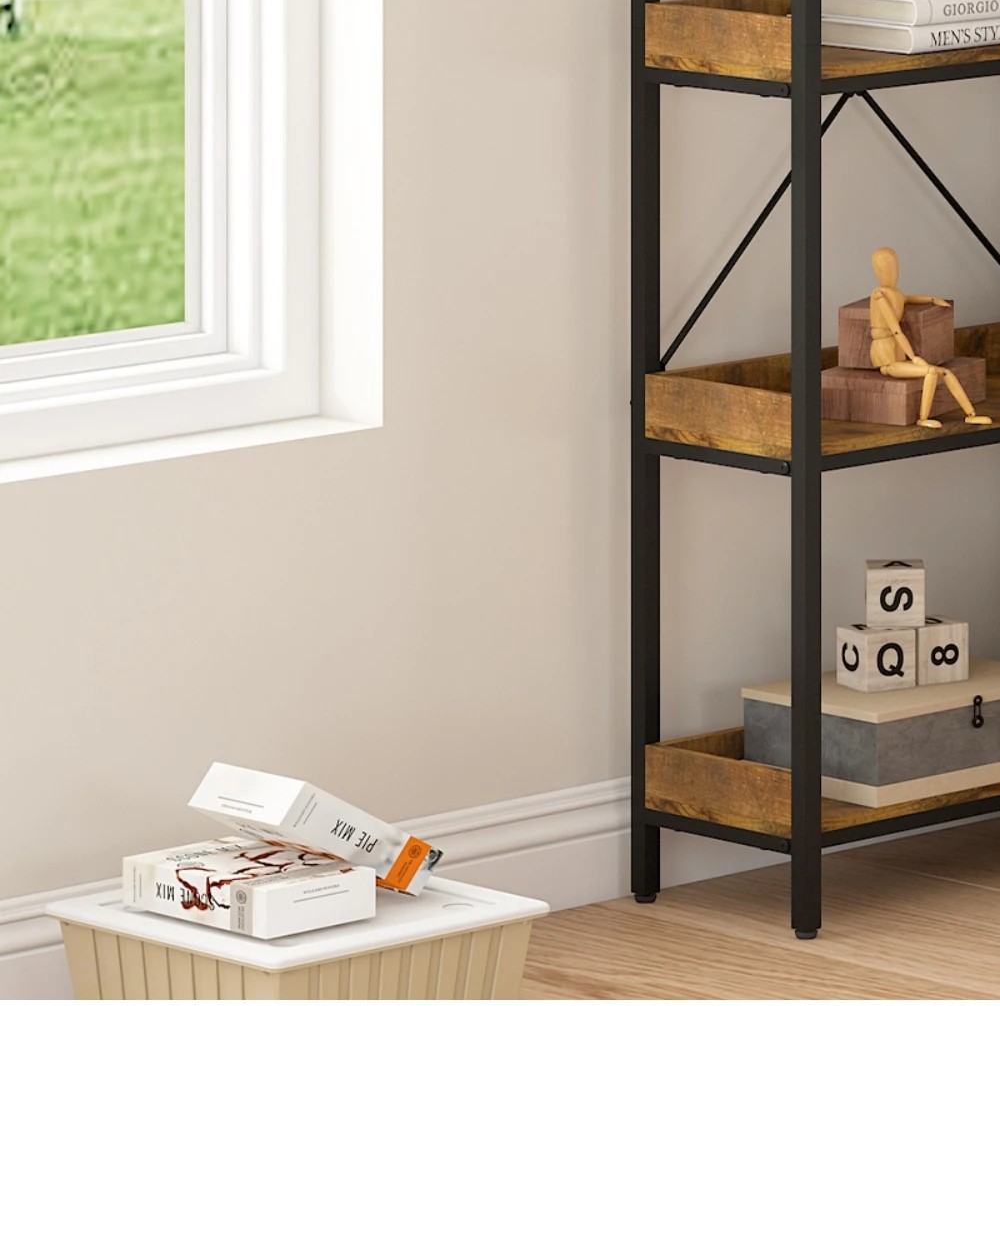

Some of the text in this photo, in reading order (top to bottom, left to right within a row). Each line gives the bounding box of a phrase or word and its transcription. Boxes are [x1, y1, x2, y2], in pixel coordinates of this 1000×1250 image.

[943, 0, 999, 17] GIORGIO
[930, 28, 971, 48] MEN'S
[880, 586, 913, 612] S
[877, 642, 904, 677] Q
[931, 643, 959, 666] 8
[330, 819, 378, 854] PIE MIX
[156, 882, 174, 902] MIX
